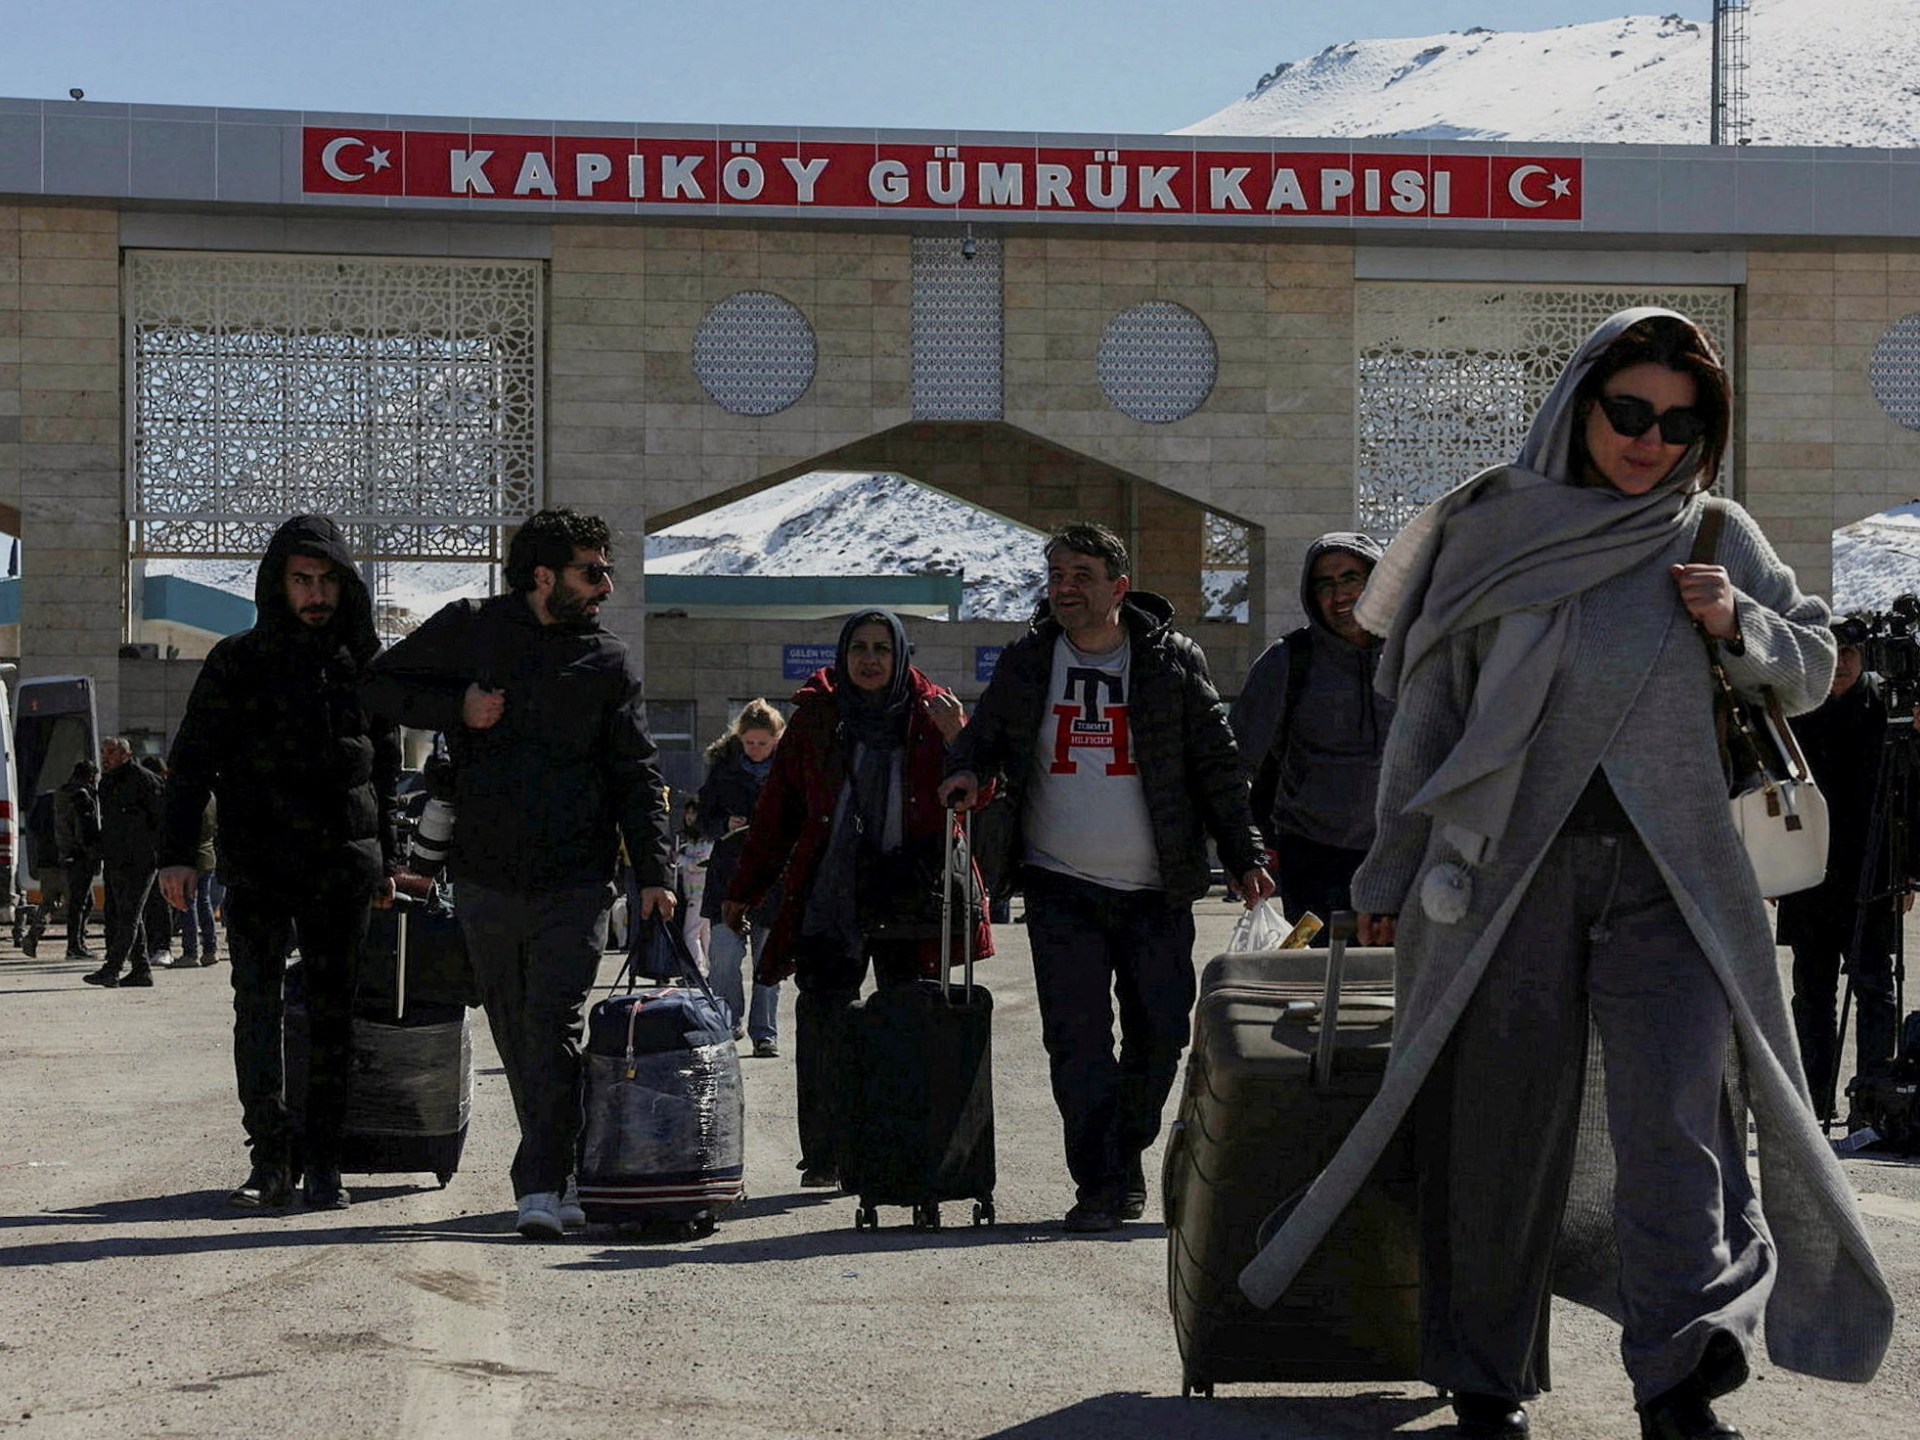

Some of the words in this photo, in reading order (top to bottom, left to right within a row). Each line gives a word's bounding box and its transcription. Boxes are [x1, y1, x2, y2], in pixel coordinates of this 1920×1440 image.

[450, 142, 829, 202] KAPIKÖY
[868, 147, 1181, 209] GÜMRÜK
[1209, 167, 1451, 215] KAPISI
[1076, 721, 1108, 731] TOMMY
[1071, 735, 1113, 745] HILFIGER
